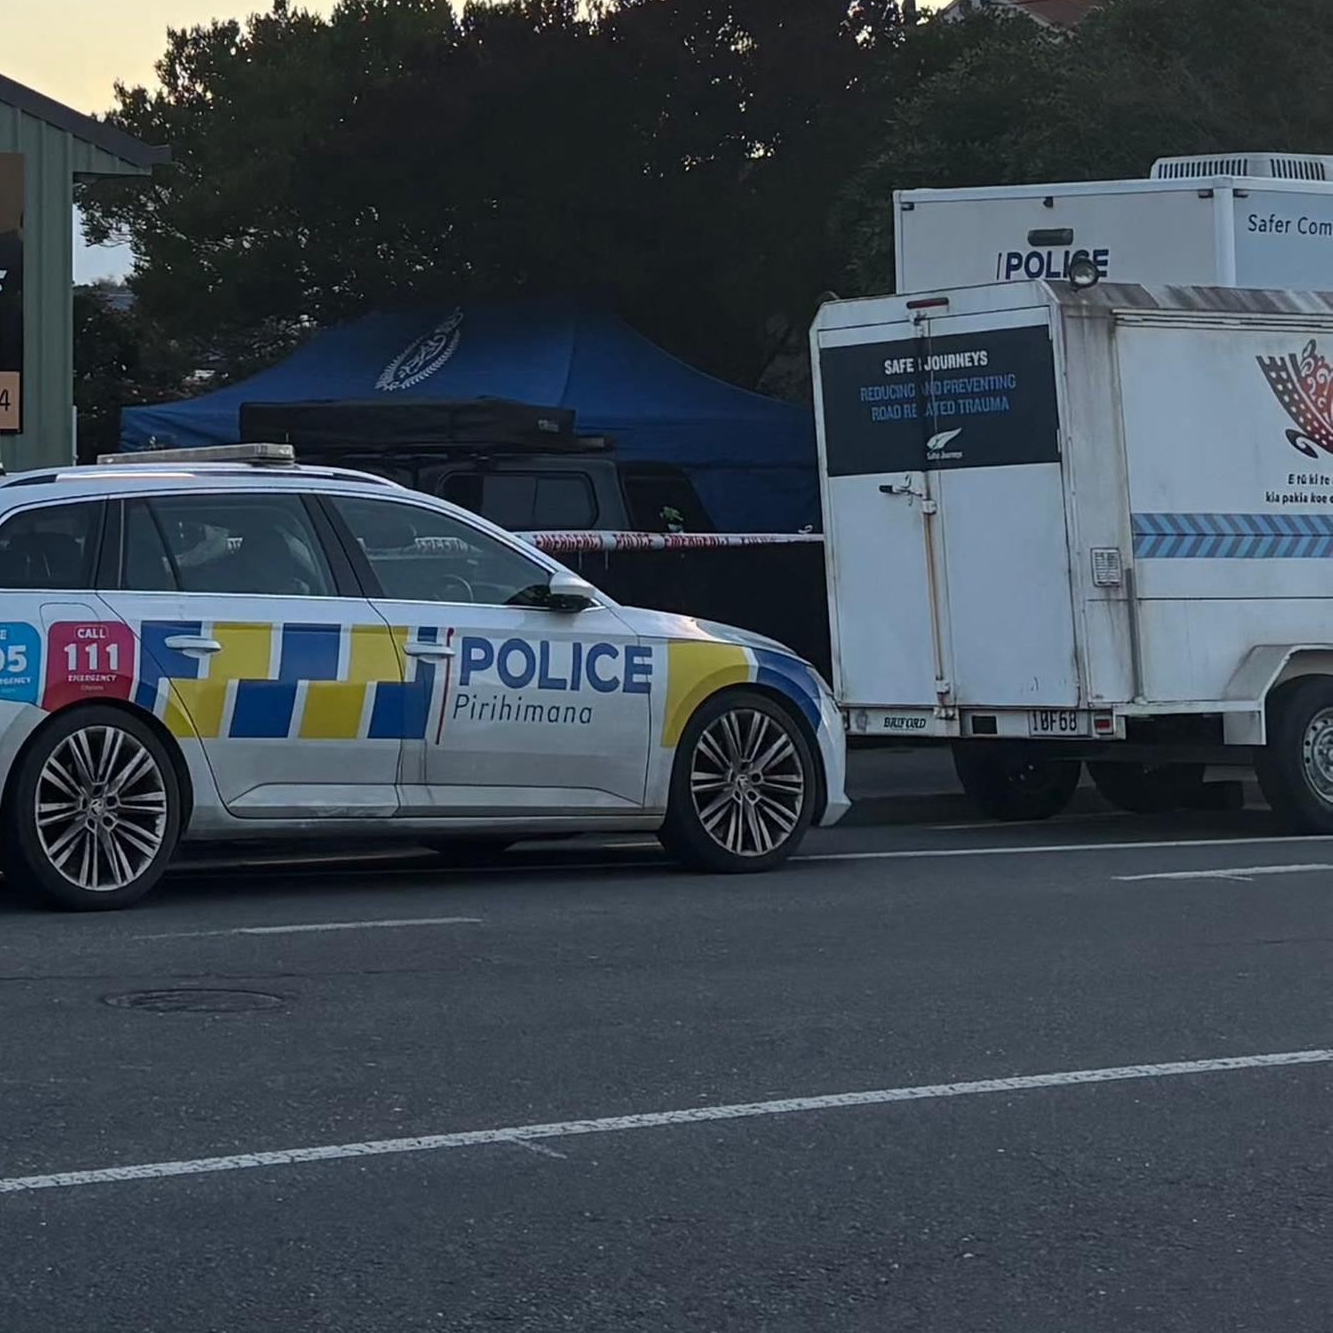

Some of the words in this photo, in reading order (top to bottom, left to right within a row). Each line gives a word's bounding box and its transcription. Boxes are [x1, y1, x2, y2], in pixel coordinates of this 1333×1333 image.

[1247, 214, 1291, 234] Safer
[884, 357, 914, 375] SAFE
[924, 351, 988, 371] JOURNEYS
[860, 383, 915, 401] REDUCING
[943, 374, 1016, 395] PREVENTING
[871, 405, 901, 421] ROAD
[958, 396, 1009, 415] TRAUMA
[1288, 474, 1294, 484] E
[1265, 491, 1280, 503] kia
[1282, 491, 1308, 505] pakia
[1310, 492, 1327, 503] koe
[77, 629, 106, 639] CALL
[64, 643, 118, 671] 111
[459, 636, 653, 694] POLICE
[68, 674, 117, 682] EMERGENCY
[452, 693, 592, 724] Pirihimana
